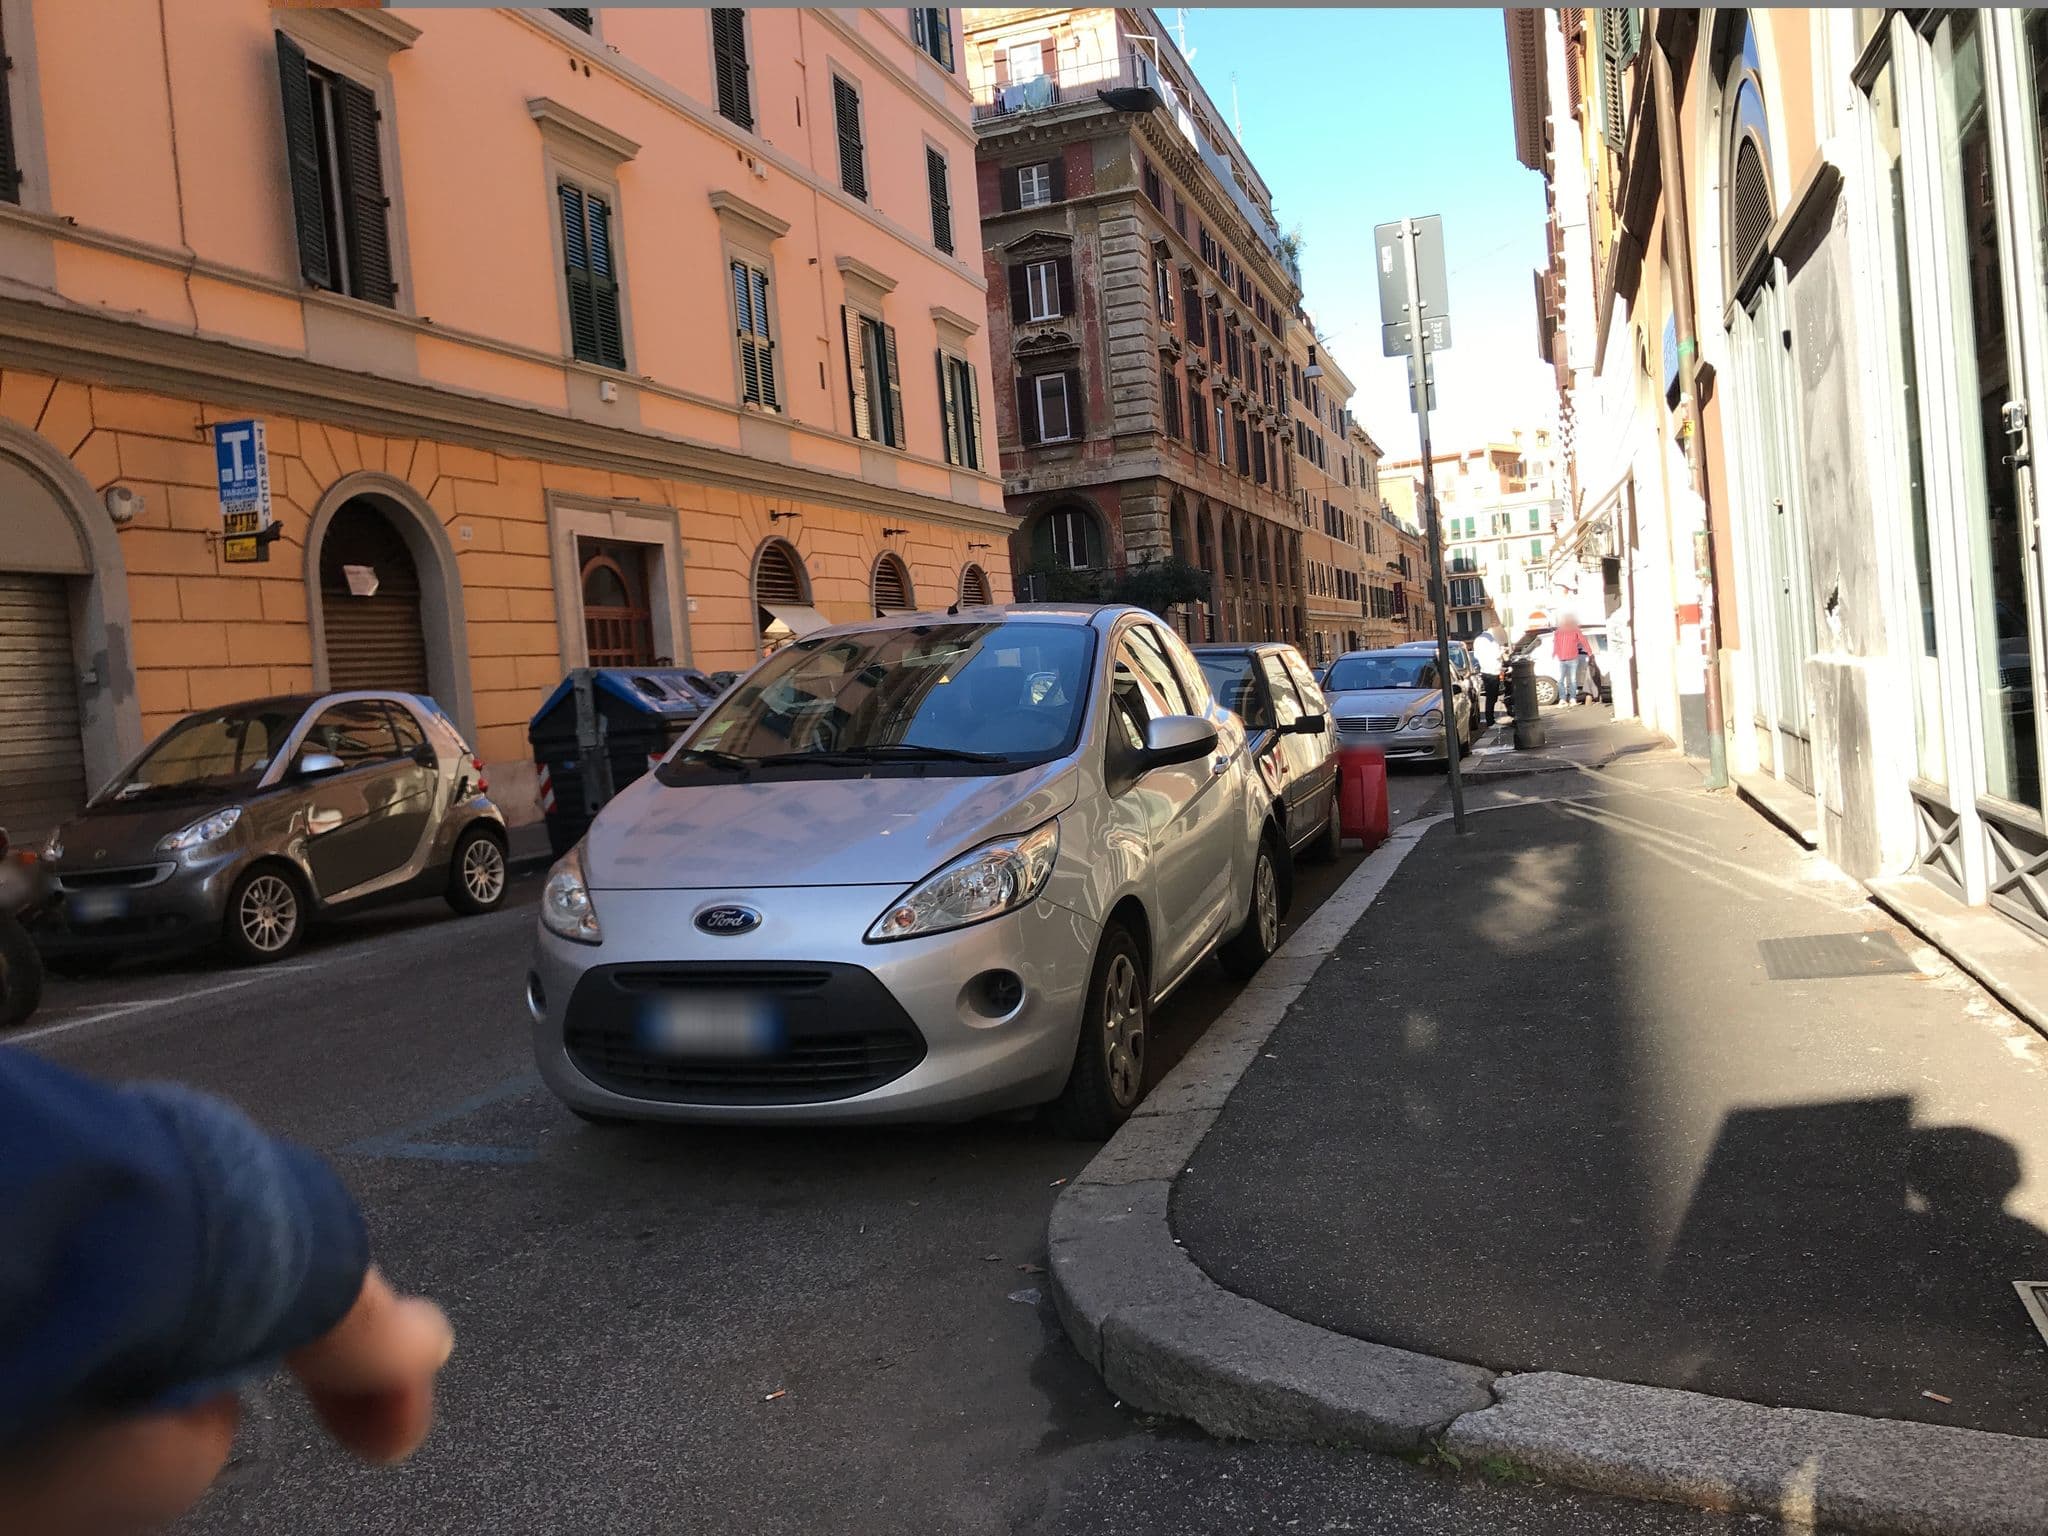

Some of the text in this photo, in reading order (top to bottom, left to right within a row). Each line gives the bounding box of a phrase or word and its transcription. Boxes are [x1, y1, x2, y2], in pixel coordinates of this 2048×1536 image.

[221, 430, 249, 481] T
[257, 428, 270, 528] TABACCHI
[224, 511, 257, 527] LOTTO
[707, 910, 745, 927] Ford
